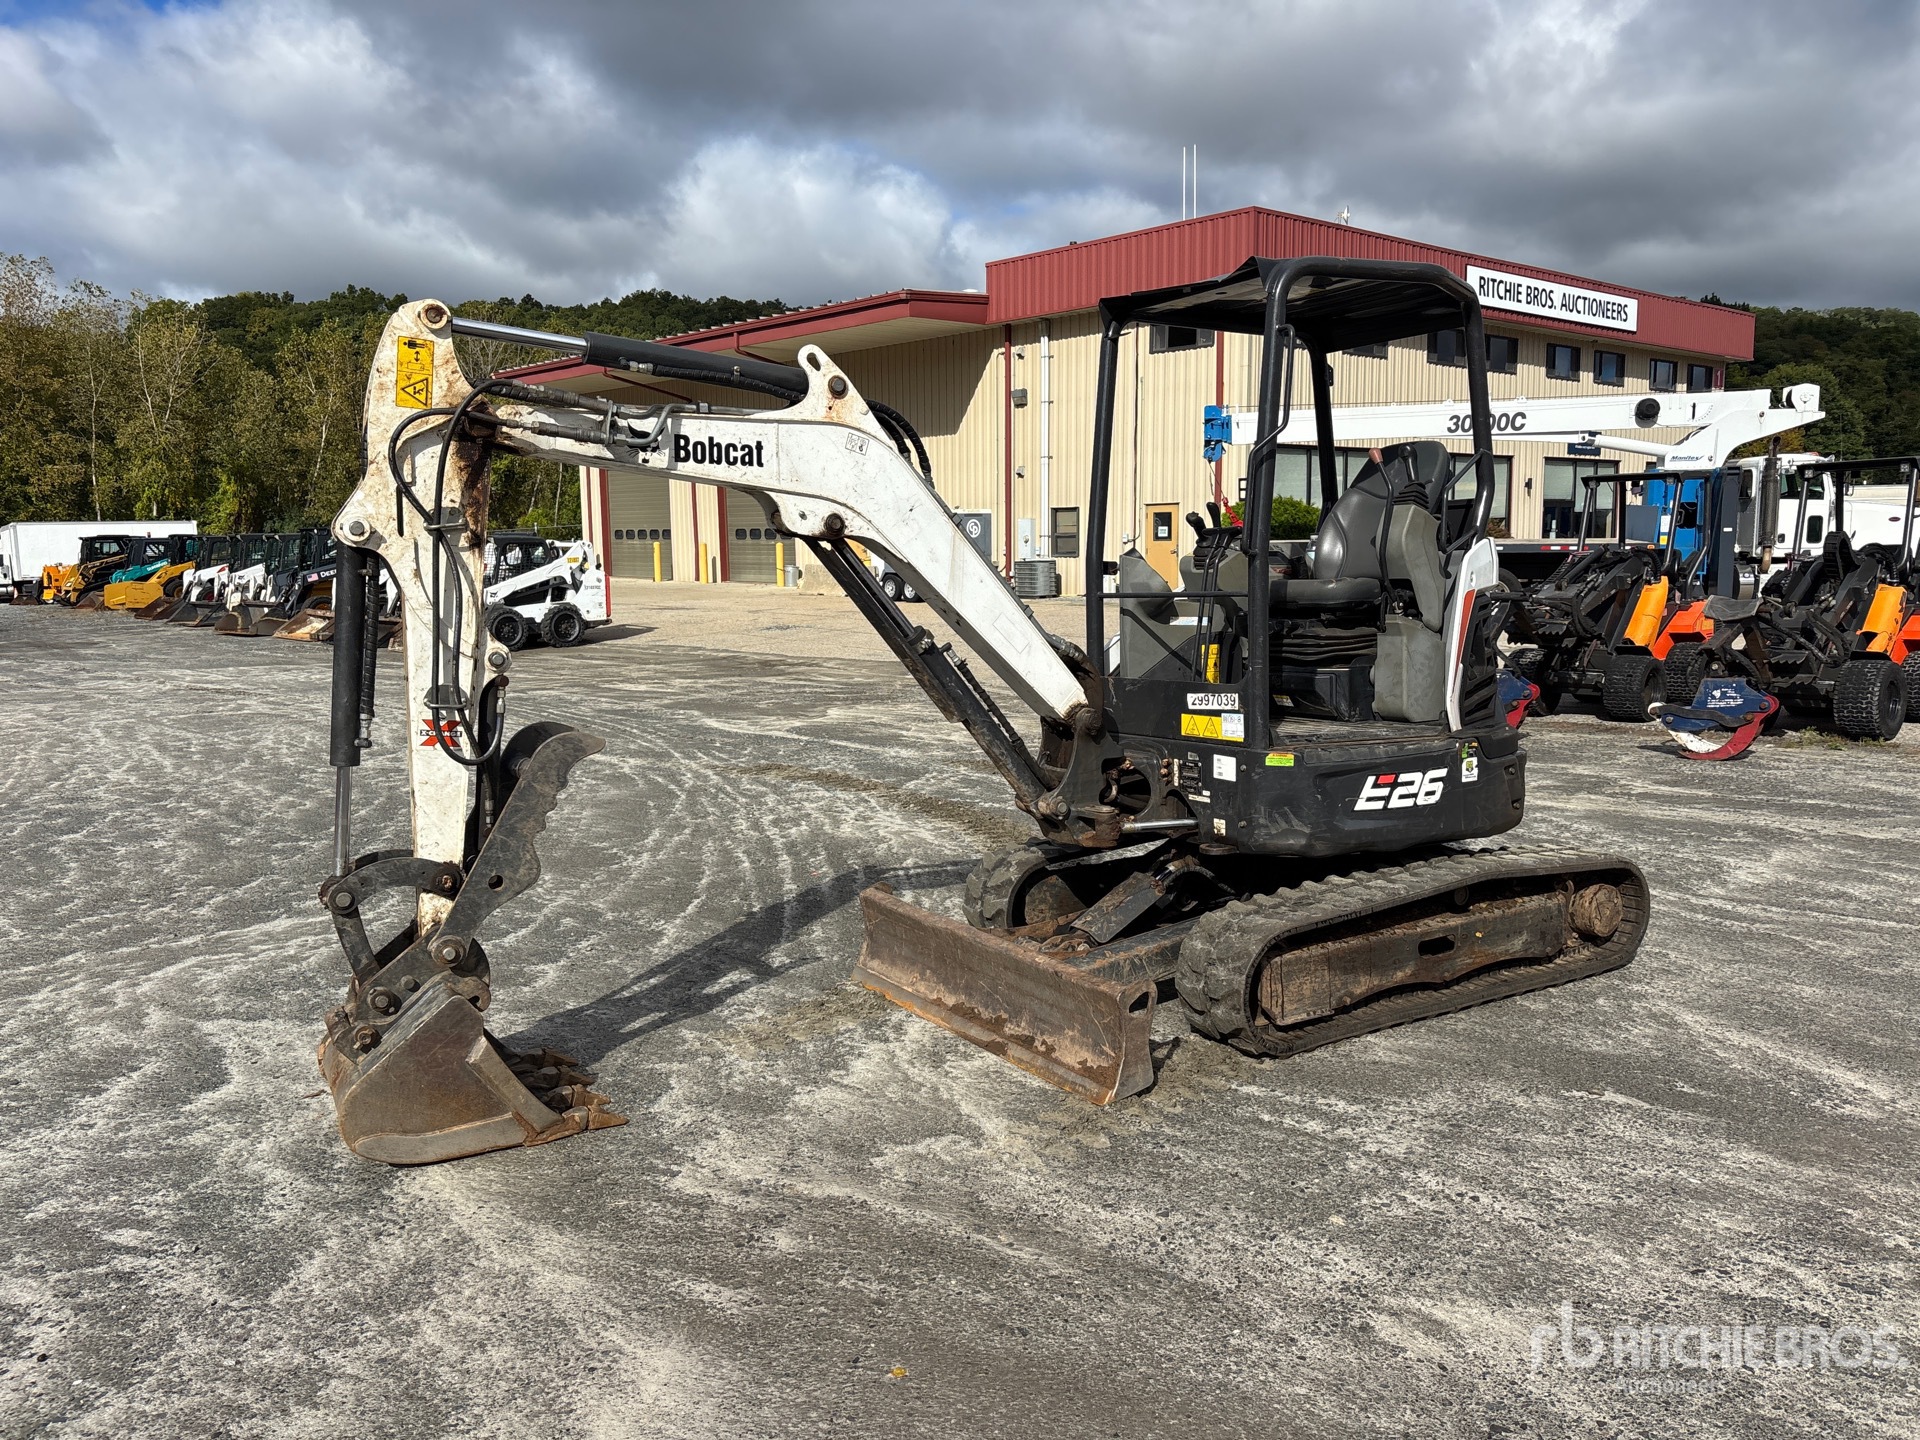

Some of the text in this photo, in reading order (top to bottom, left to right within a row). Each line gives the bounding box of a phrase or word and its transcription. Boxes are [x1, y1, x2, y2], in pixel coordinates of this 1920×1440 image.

[1479, 276, 1628, 322] RITCHIE BROS. AUCTIONEERS
[674, 433, 764, 467] Bobcat
[1191, 694, 1236, 707] 2997039
[1353, 767, 1449, 811] E26
